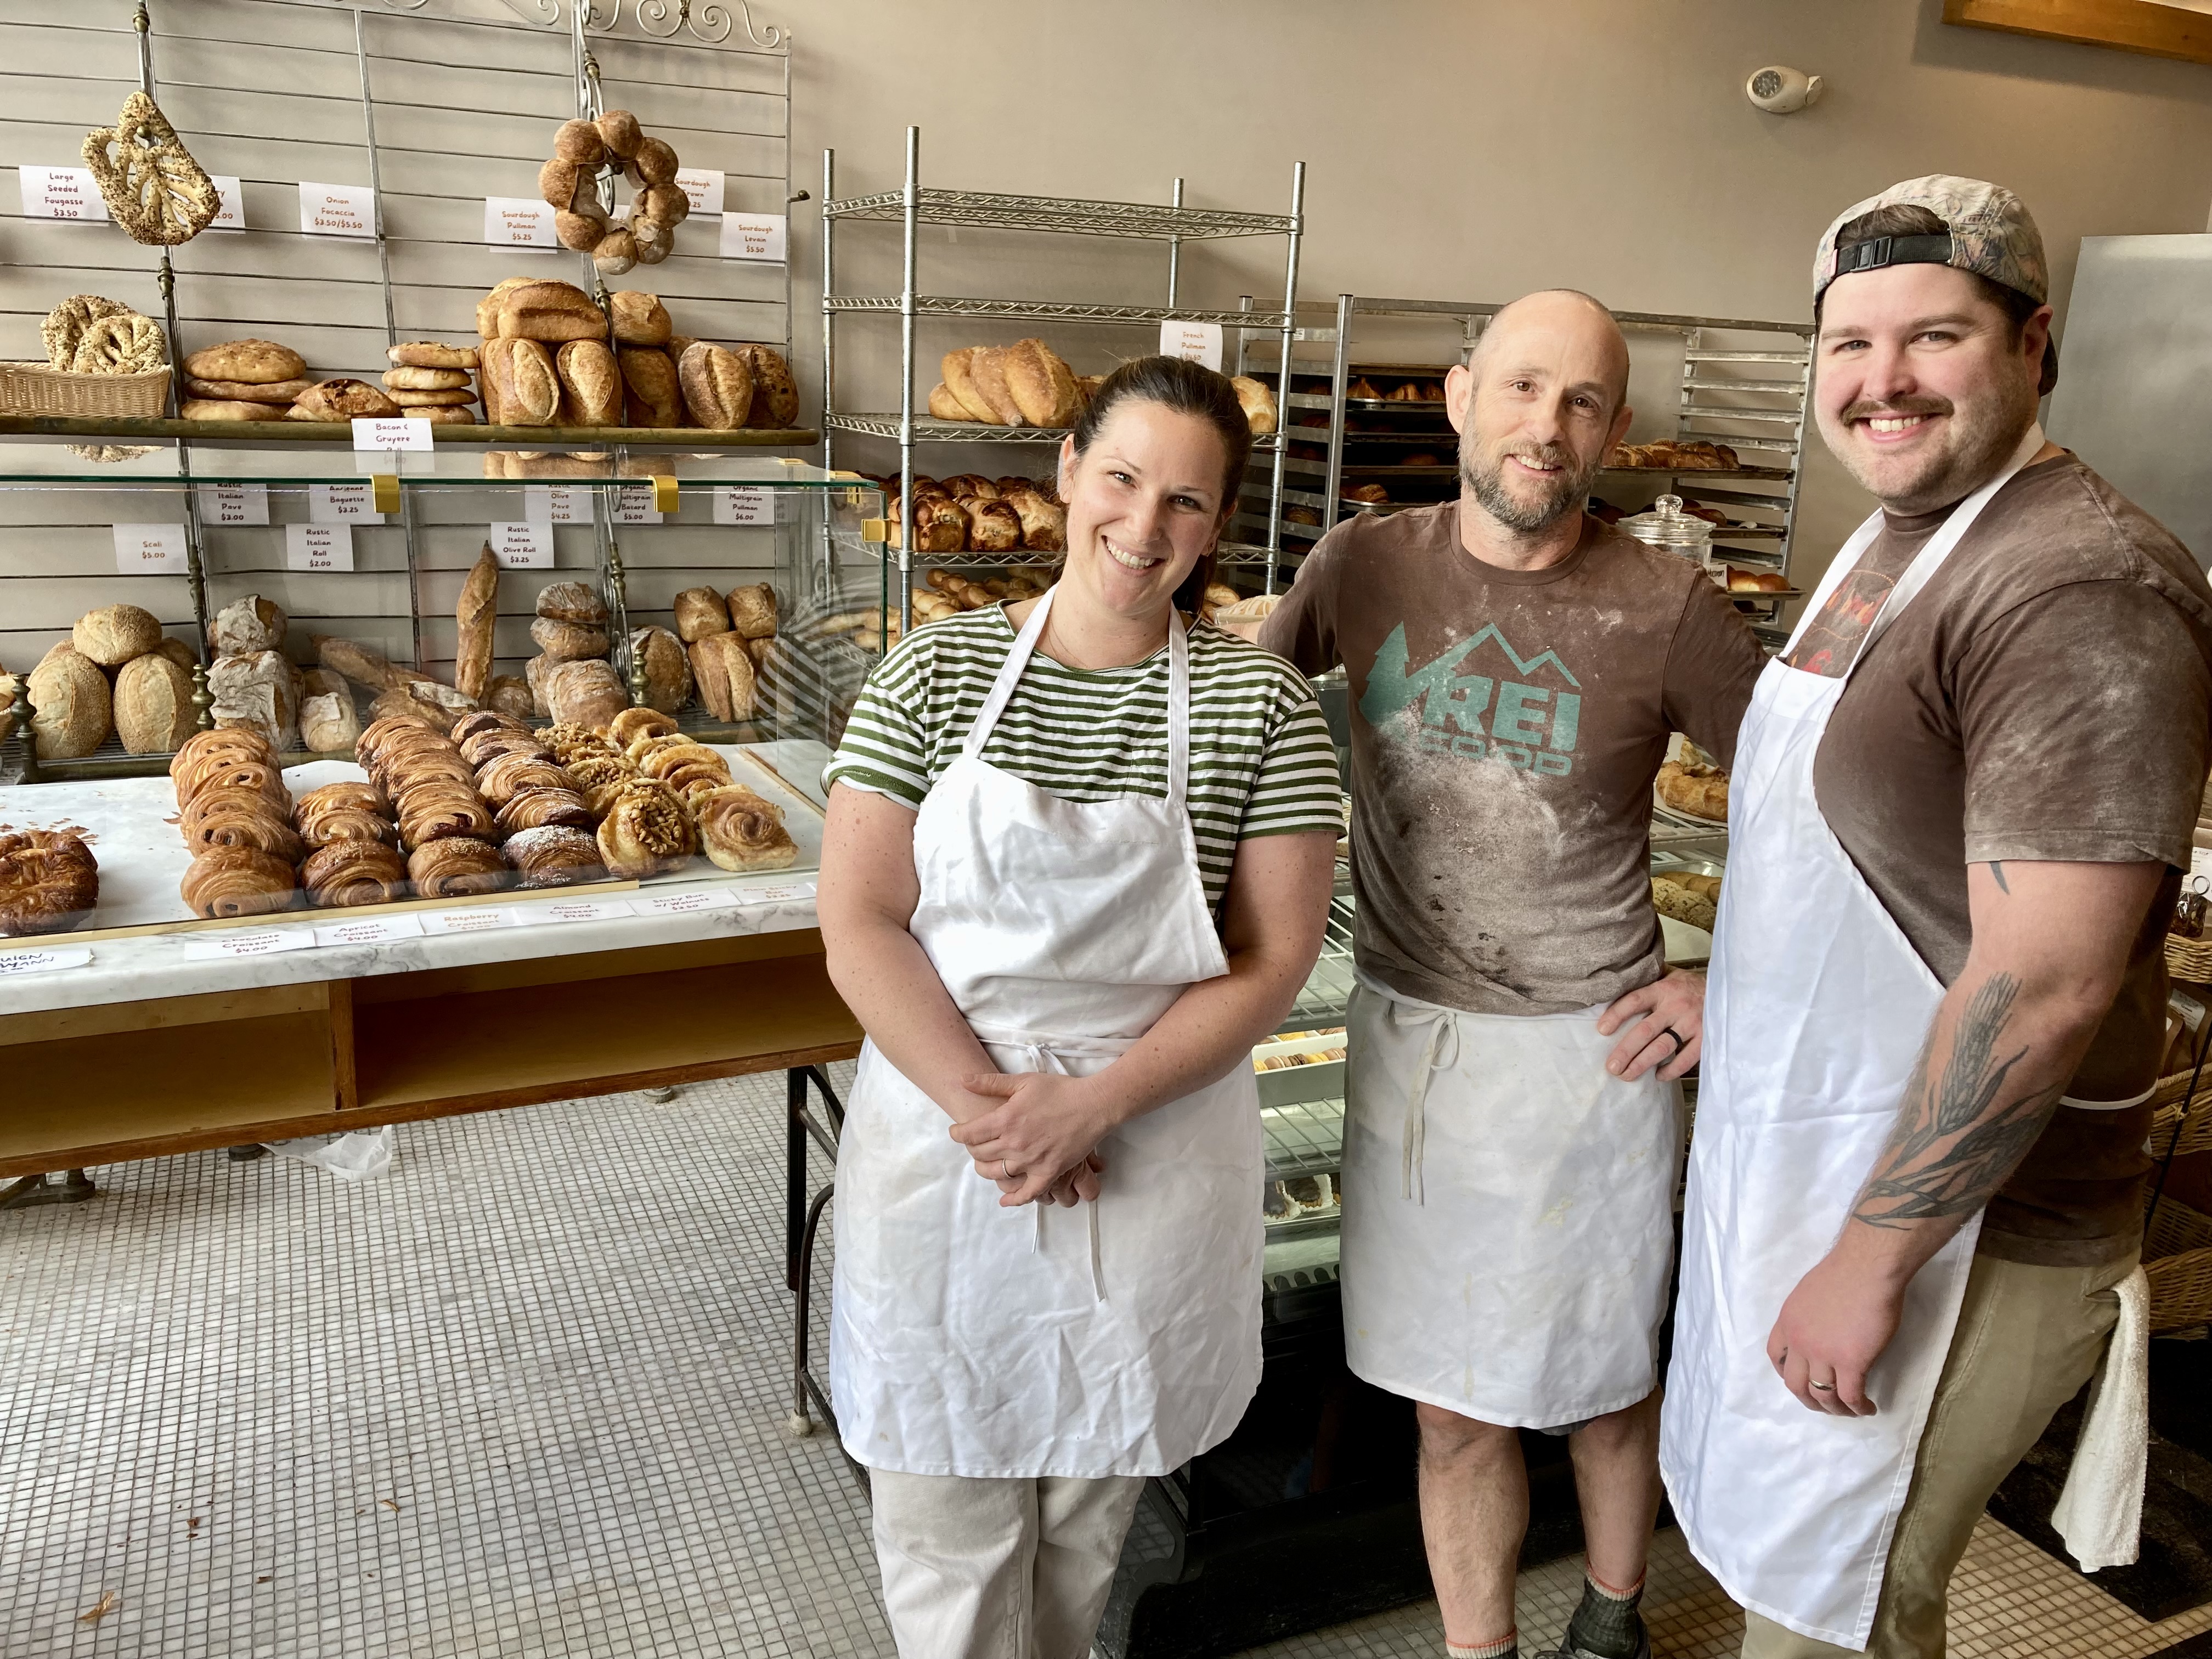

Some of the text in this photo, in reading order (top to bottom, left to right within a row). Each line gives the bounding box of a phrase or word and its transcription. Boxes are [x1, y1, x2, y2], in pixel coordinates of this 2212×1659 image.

[49, 172, 74, 182] Large
[675, 178, 711, 189] Sourdough
[48, 184, 78, 193] Seeded
[684, 189, 704, 198] rown
[44, 196, 83, 206] Fougasse
[326, 196, 349, 205] Onion
[54, 207, 78, 217] $3.50
[321, 207, 355, 216] Focaccia
[502, 211, 540, 220] Sourdough
[314, 217, 363, 229] $3.50/$5.50
[738, 224, 773, 234] Sourdough
[512, 232, 532, 240] $5.25
[746, 244, 765, 253] $5.50
[376, 435, 410, 444] Gruyere
[330, 496, 365, 505] Baguette
[729, 494, 763, 503] Multigrain
[338, 505, 359, 514] $3.25
[551, 511, 571, 520] $4.25
[623, 512, 644, 521] $5.00
[735, 512, 754, 521] $6.00
[142, 550, 165, 559] $5.00
[510, 555, 529, 563] $3.25
[309, 558, 331, 567] $2.00
[1422, 675, 1581, 752] REI
[334, 928, 388, 937] Croissant
[222, 934, 280, 943] Chocolate
[222, 939, 280, 948] Croissant
